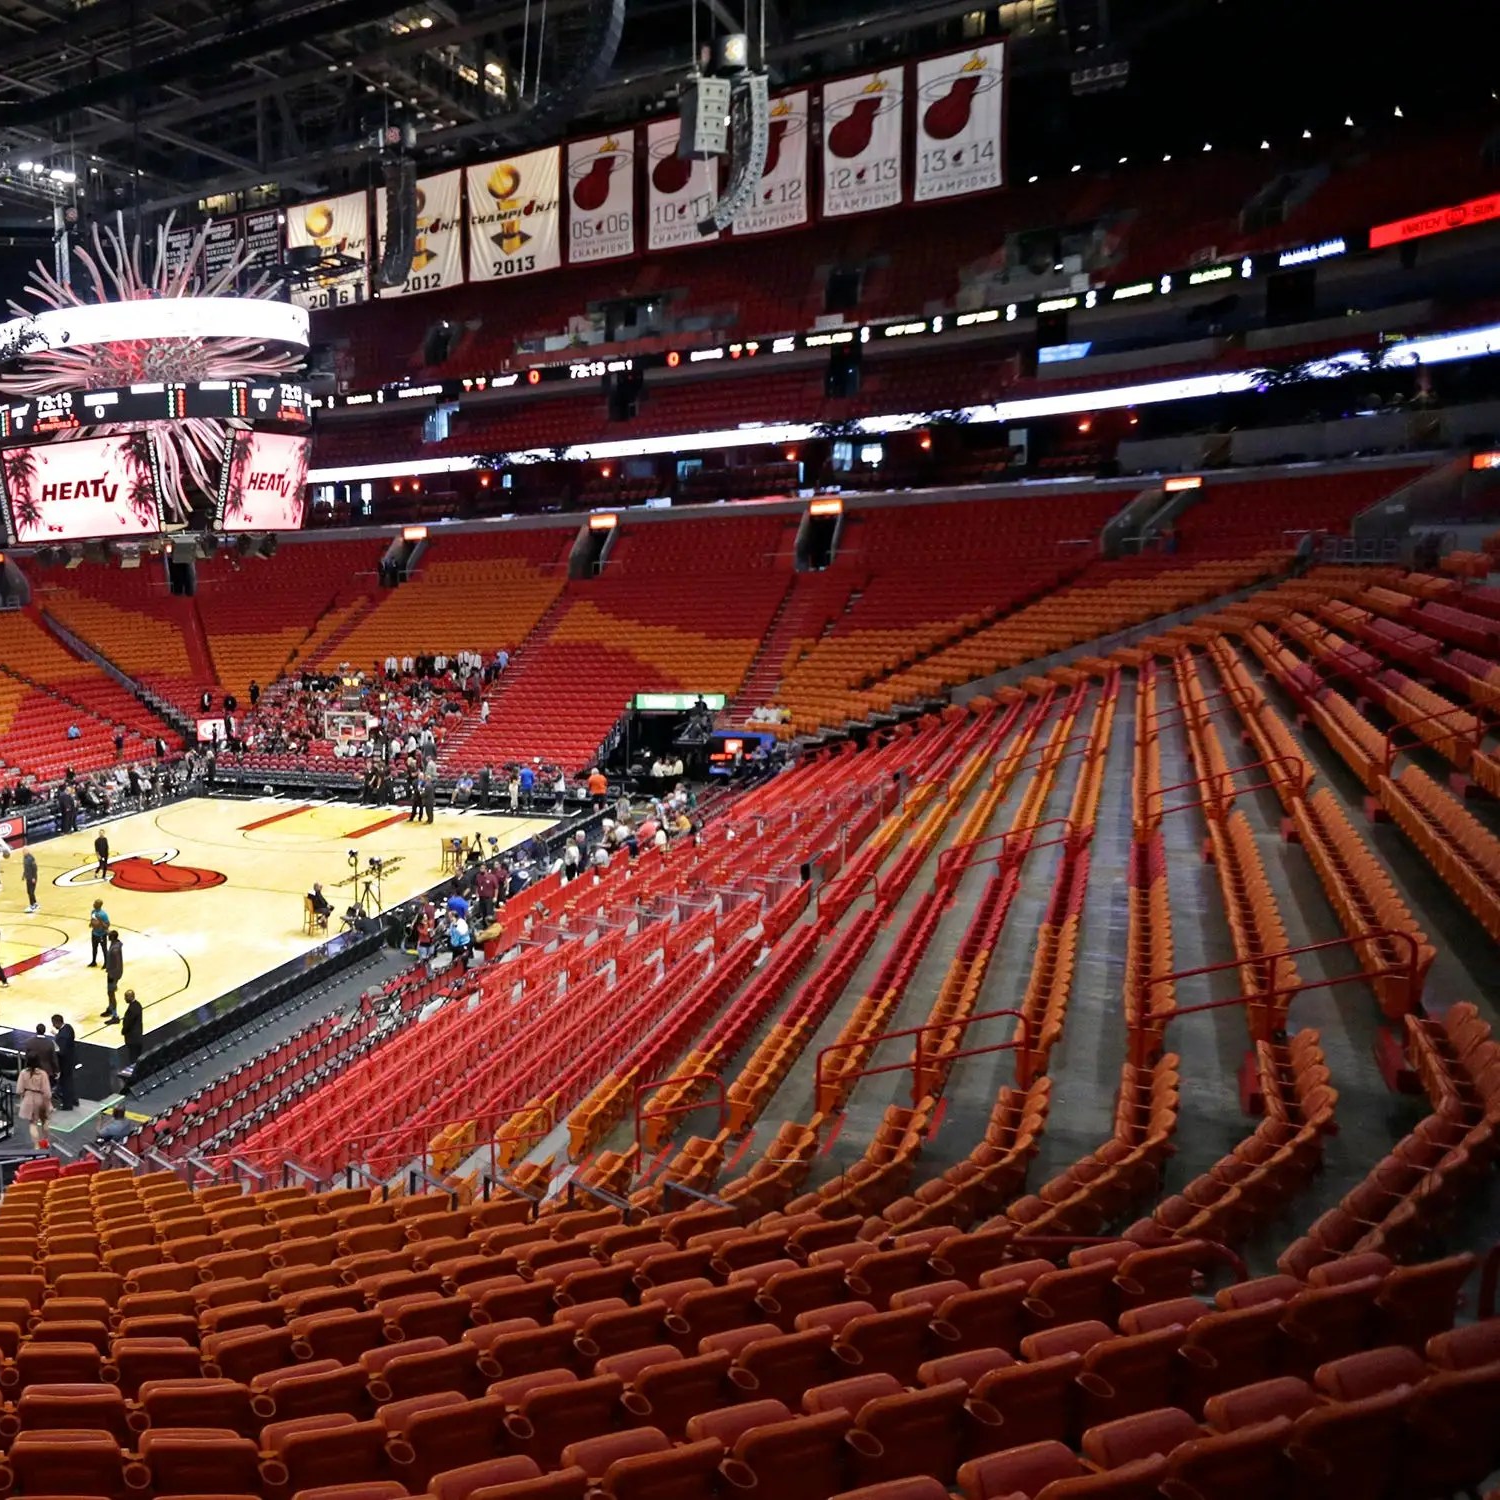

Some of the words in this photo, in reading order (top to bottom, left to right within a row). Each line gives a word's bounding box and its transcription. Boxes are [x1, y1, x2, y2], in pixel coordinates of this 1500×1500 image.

[921, 150, 947, 175] 13
[970, 140, 995, 165] 14
[829, 168, 851, 190] 12
[873, 158, 898, 183] 13
[779, 180, 802, 203] 12
[654, 203, 677, 225] 10
[571, 218, 594, 240] 05
[607, 212, 630, 234] 06
[1401, 215, 1442, 235] WATCH
[493, 255, 536, 276] 2013
[401, 272, 442, 294] 2012
[308, 290, 349, 310] 206
[666, 352, 679, 367] 0
[36, 392, 73, 411] 73:13
[94, 405, 106, 419] 0
[257, 398, 267, 413] 0
